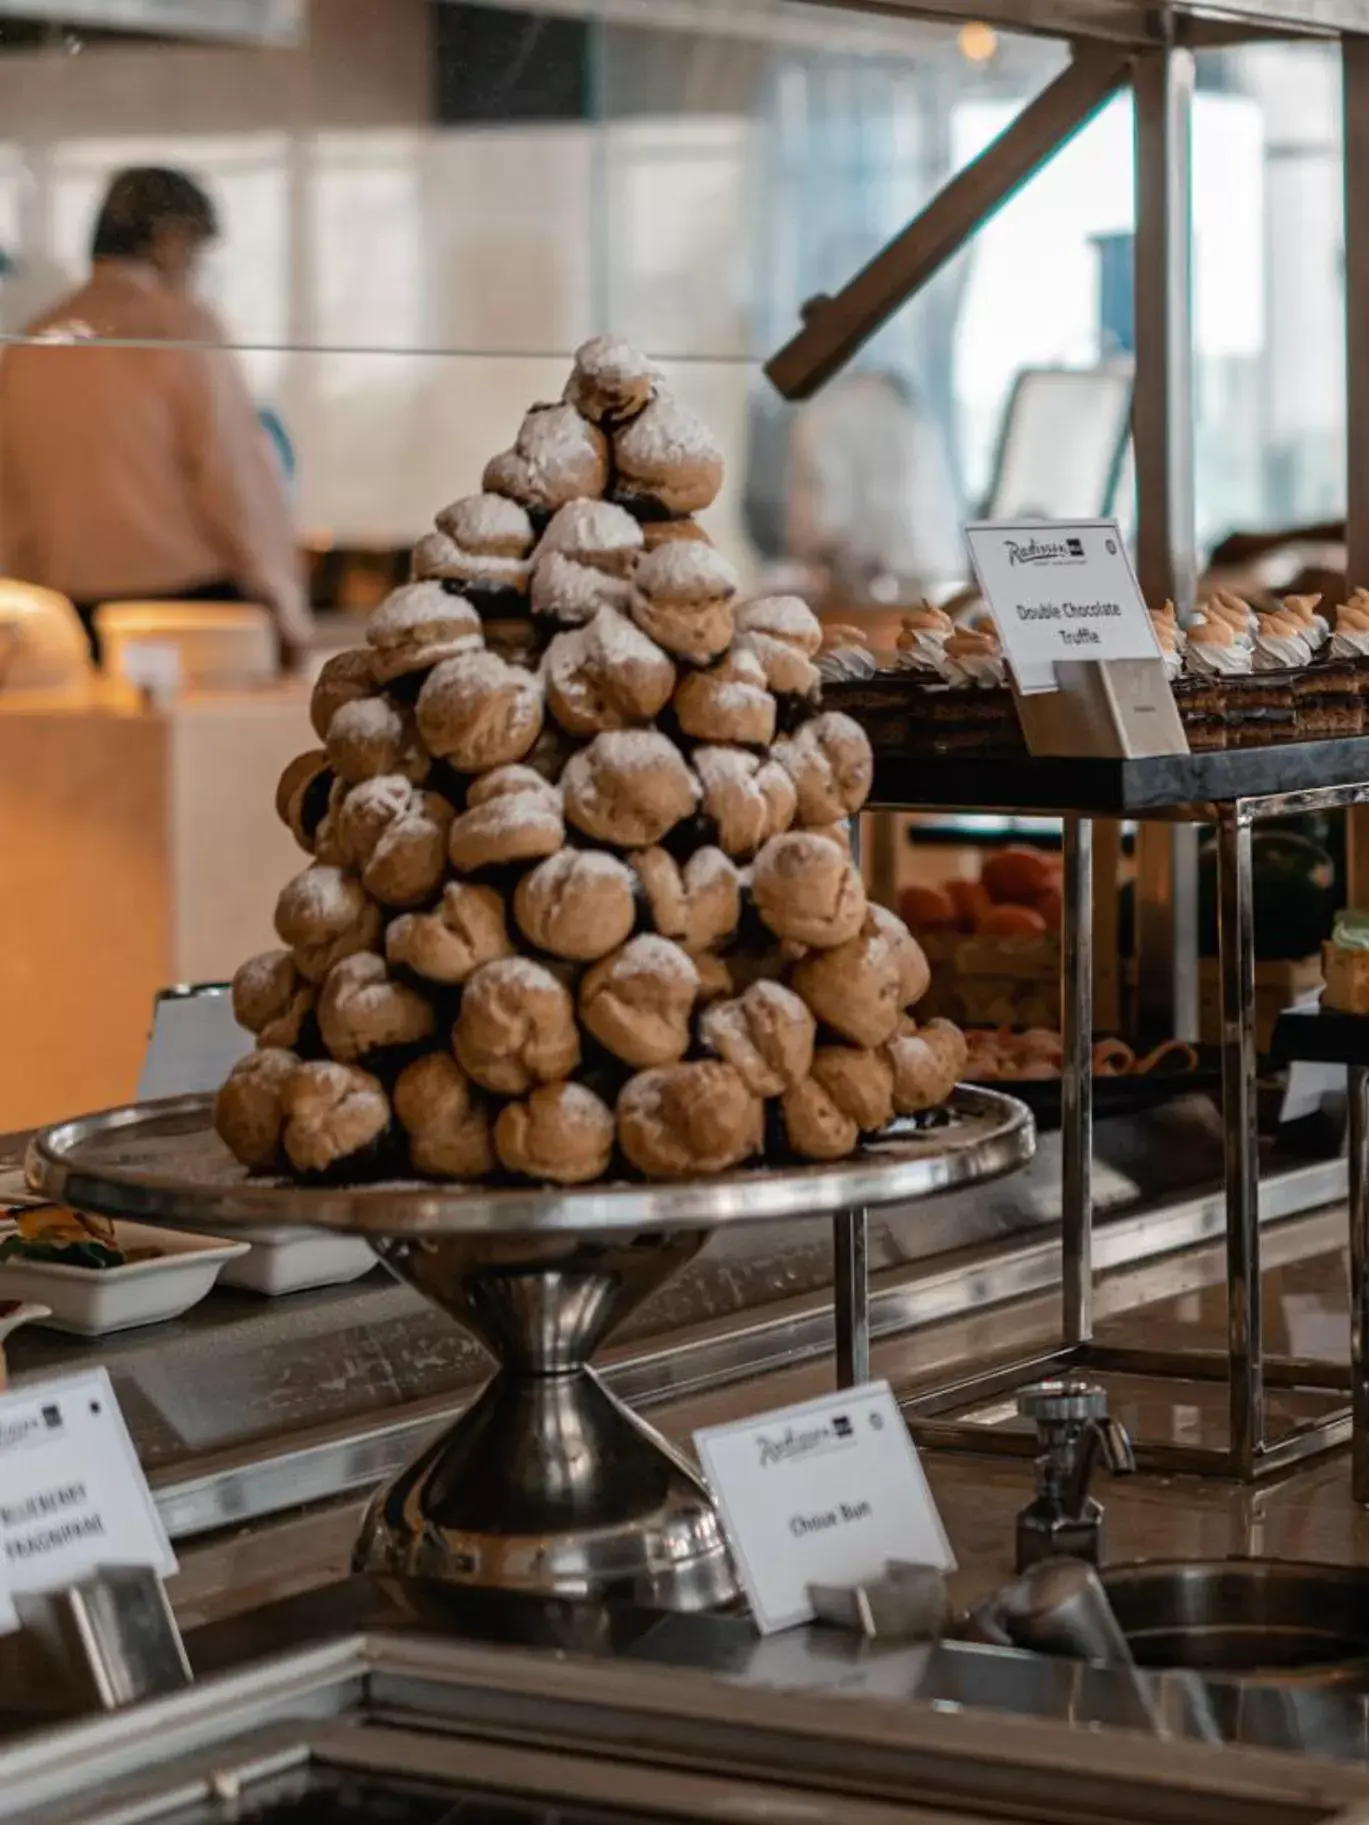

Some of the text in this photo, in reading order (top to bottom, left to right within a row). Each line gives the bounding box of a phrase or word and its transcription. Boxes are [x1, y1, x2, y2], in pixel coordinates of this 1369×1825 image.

[1004, 538, 1066, 566] Radisson
[1016, 601, 1121, 620] Double Chocolate
[1058, 627, 1101, 645] Truffle
